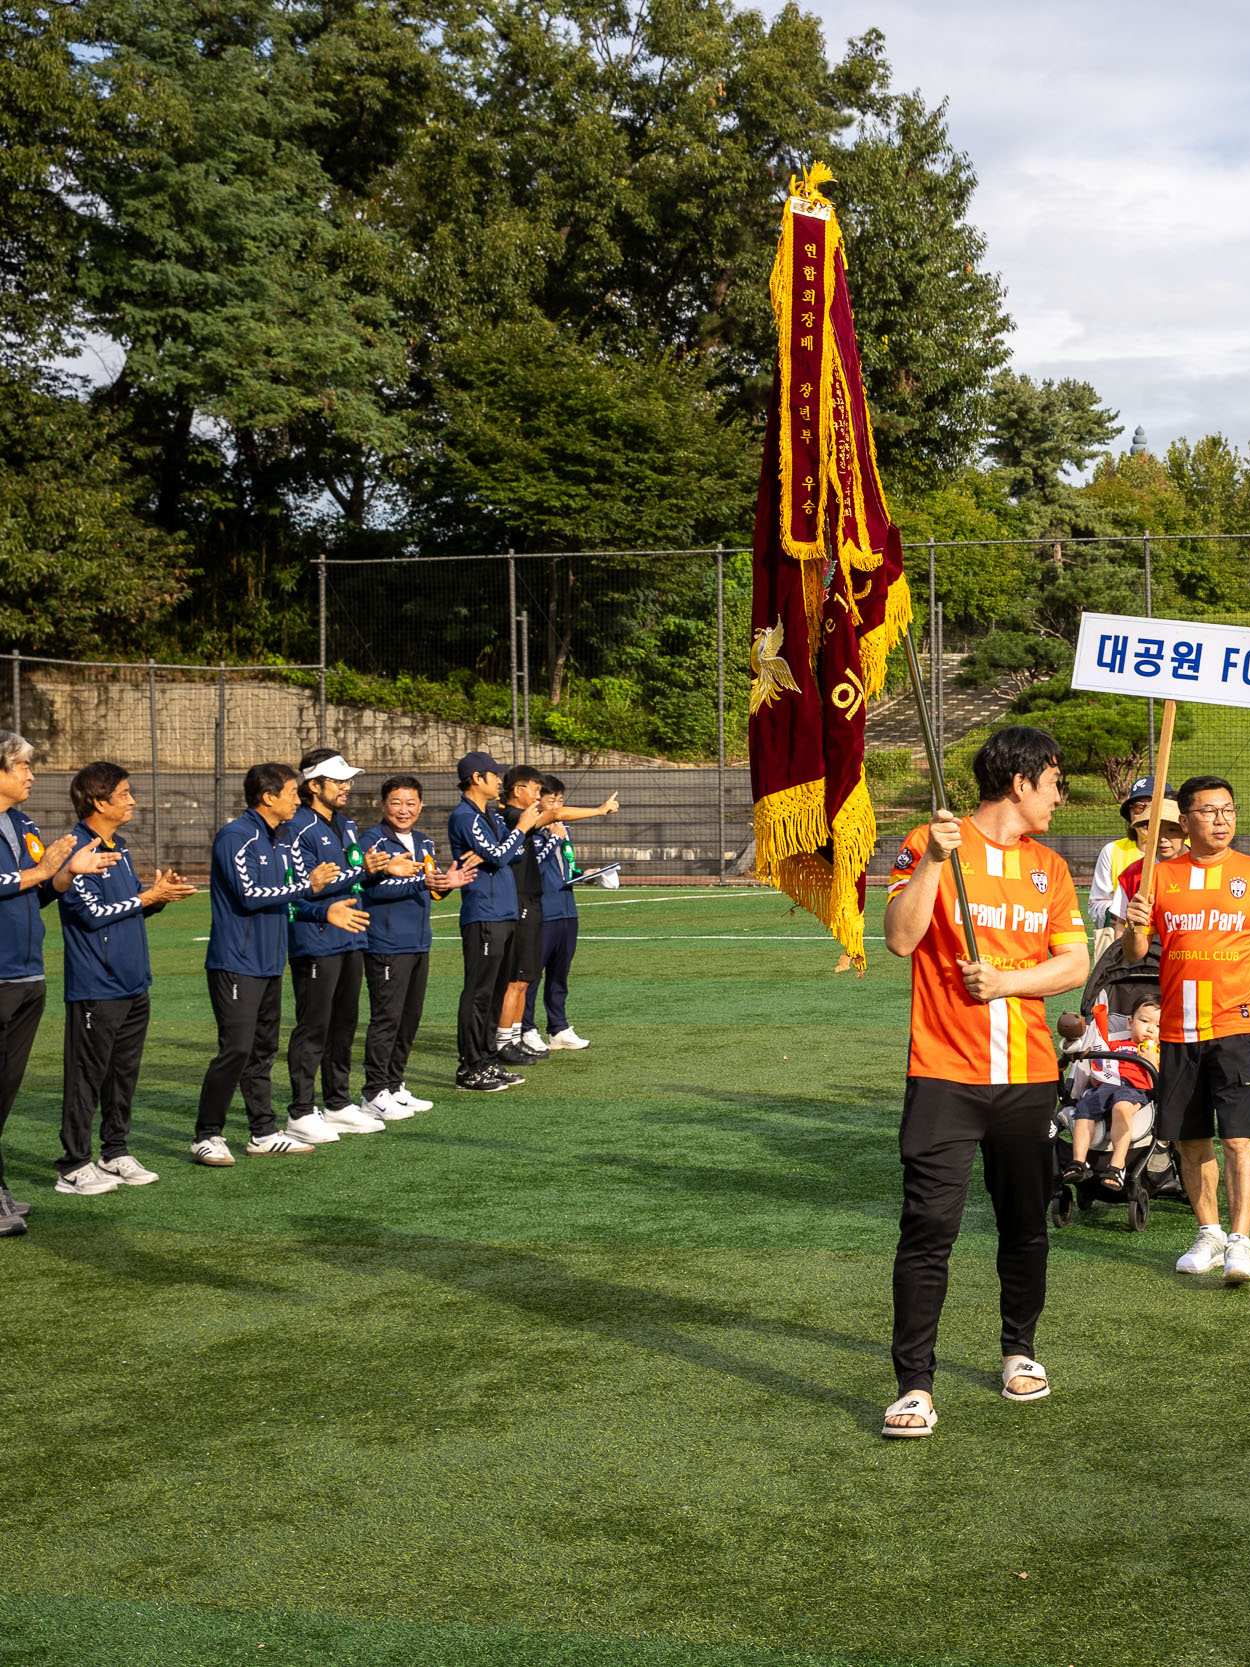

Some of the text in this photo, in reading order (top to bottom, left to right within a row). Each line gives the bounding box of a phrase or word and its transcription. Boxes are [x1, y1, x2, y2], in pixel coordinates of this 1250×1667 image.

[799, 243, 818, 515] 연합회장배 장년부 우승
[1096, 634, 1203, 681] 대공원
[1164, 909, 1246, 933] Grand Park
[1168, 950, 1240, 961] FOOTBALL CLUB
